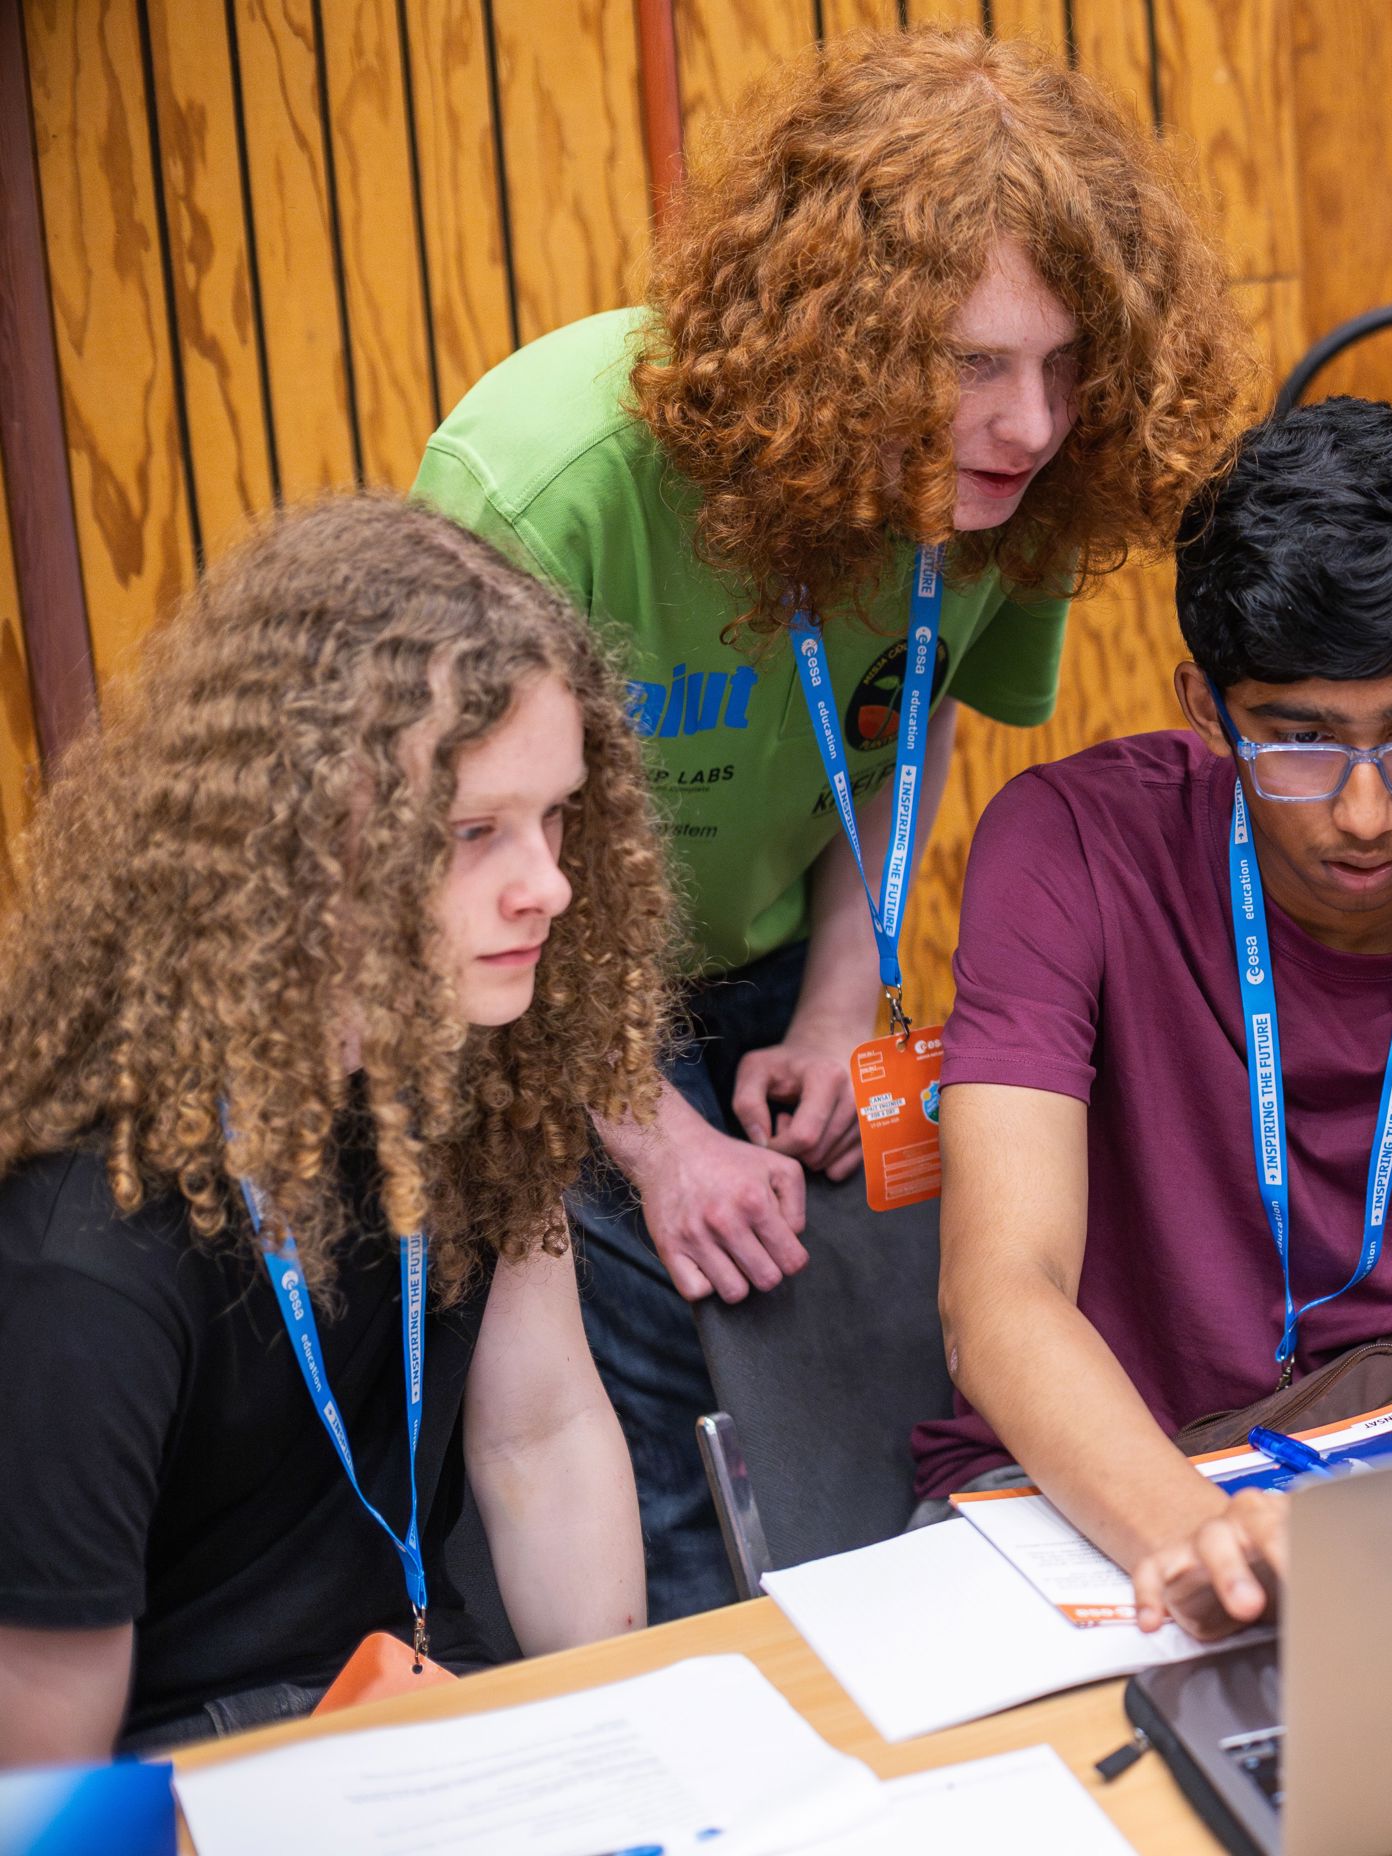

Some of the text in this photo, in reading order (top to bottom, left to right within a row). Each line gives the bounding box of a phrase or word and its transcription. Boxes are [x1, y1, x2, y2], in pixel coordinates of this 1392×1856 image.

[817, 700, 837, 759] education
[907, 690, 920, 750] education
[677, 765, 735, 785] LABS
[886, 781, 913, 935] INSPIRING THE FUTURE
[1241, 859, 1254, 920] education
[1256, 1017, 1278, 1170] INSPIRING THE FUTURE
[1375, 1141, 1392, 1210] INSPIRING
[411, 1279, 419, 1306] THE
[301, 1333, 322, 1393] education
